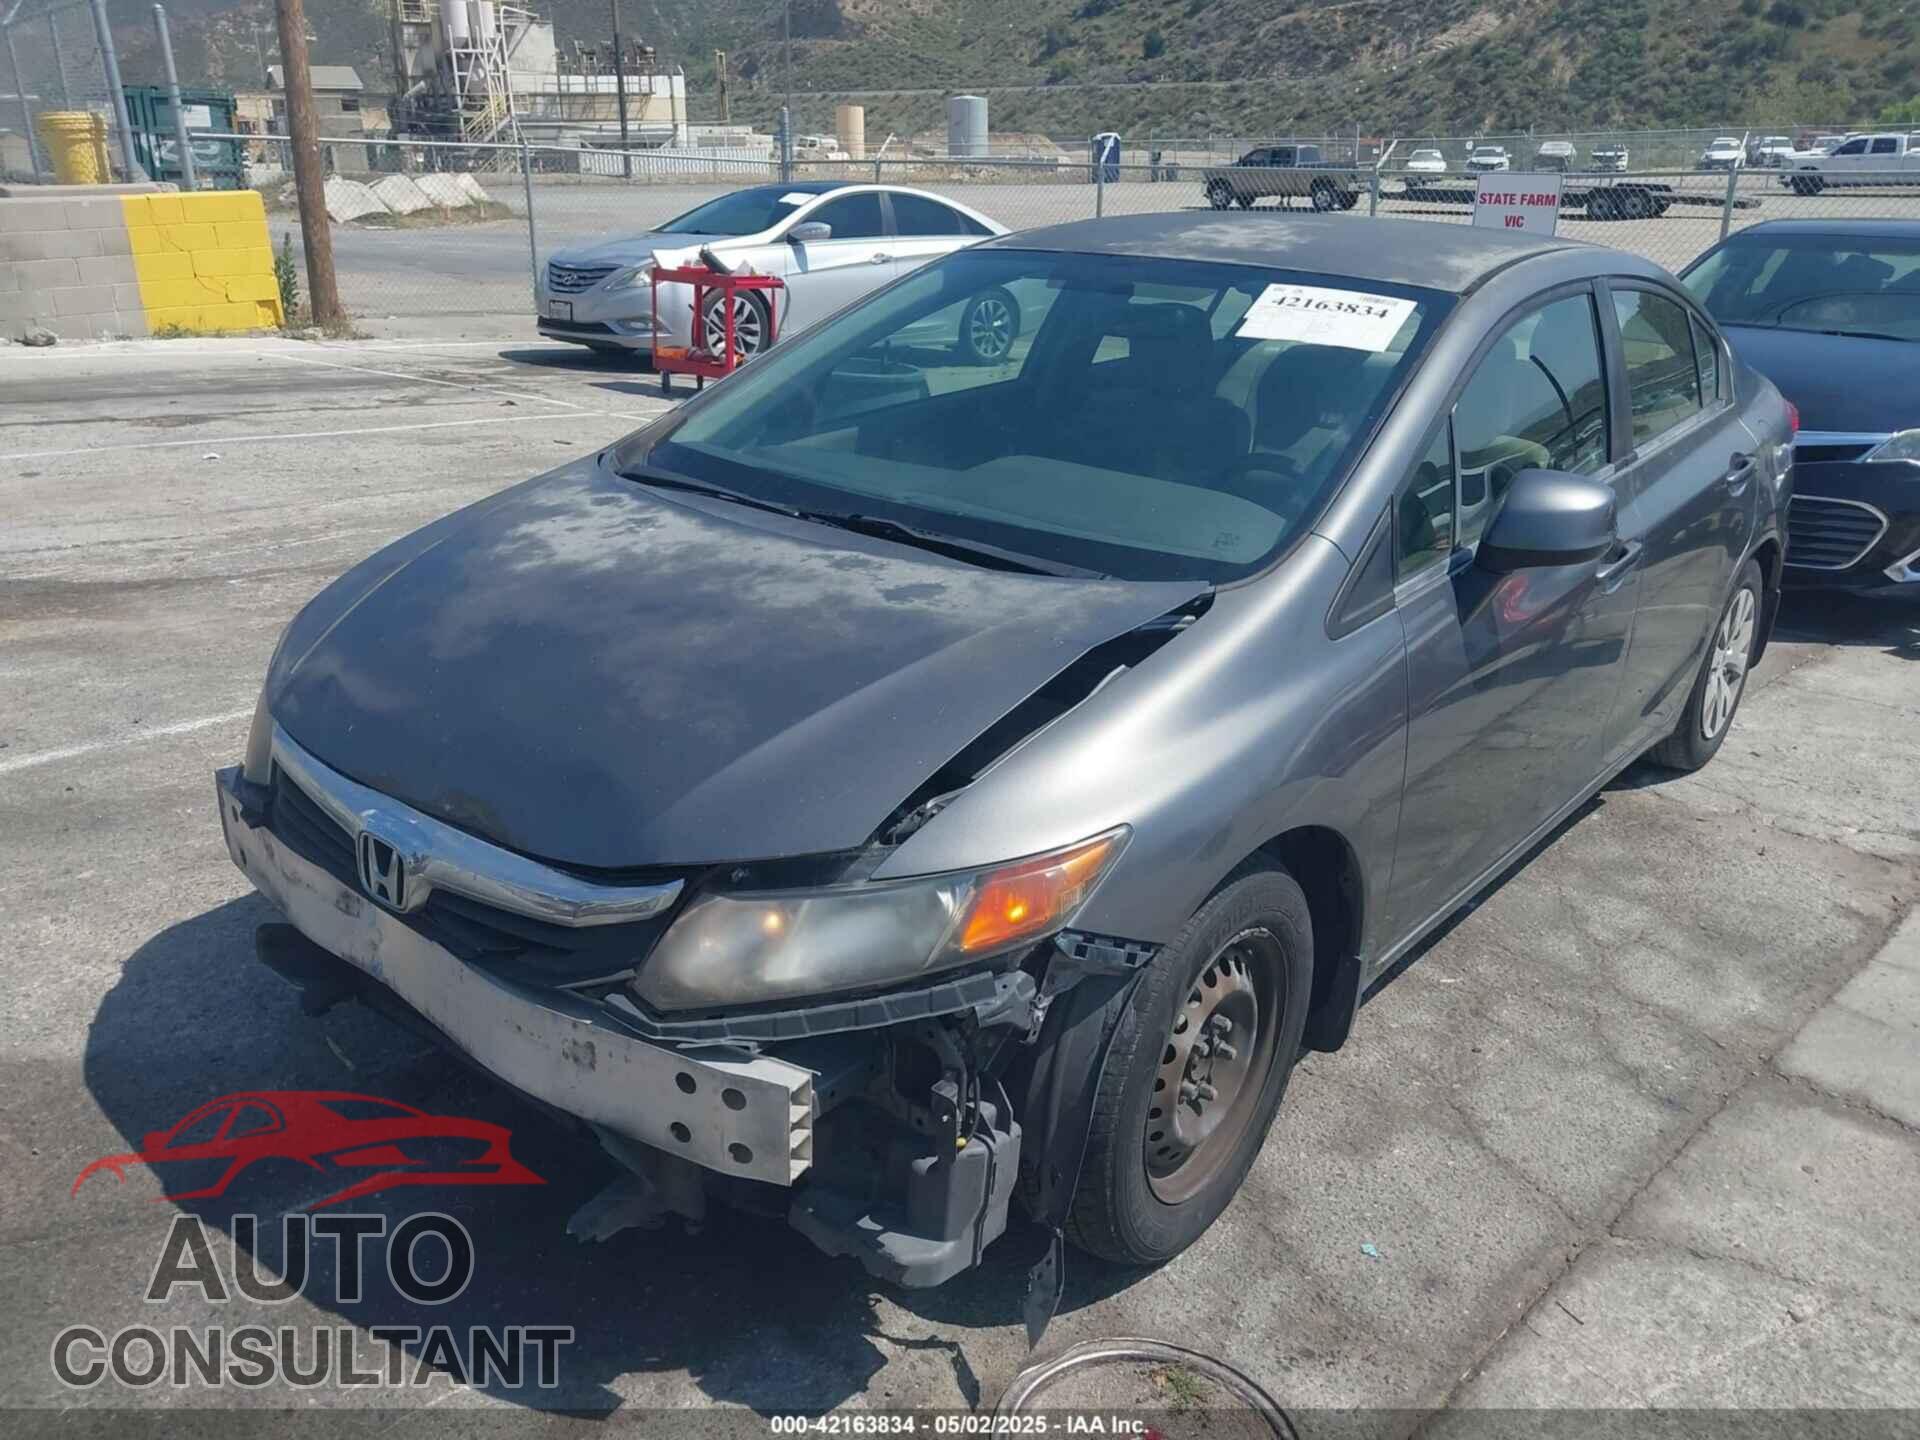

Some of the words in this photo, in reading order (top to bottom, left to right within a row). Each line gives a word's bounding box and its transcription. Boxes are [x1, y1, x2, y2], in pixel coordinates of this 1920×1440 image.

[1479, 193, 1517, 205] STATE
[1520, 193, 1556, 206] FARM
[1504, 215, 1524, 228] VIC
[1272, 296, 1388, 319] 42163834
